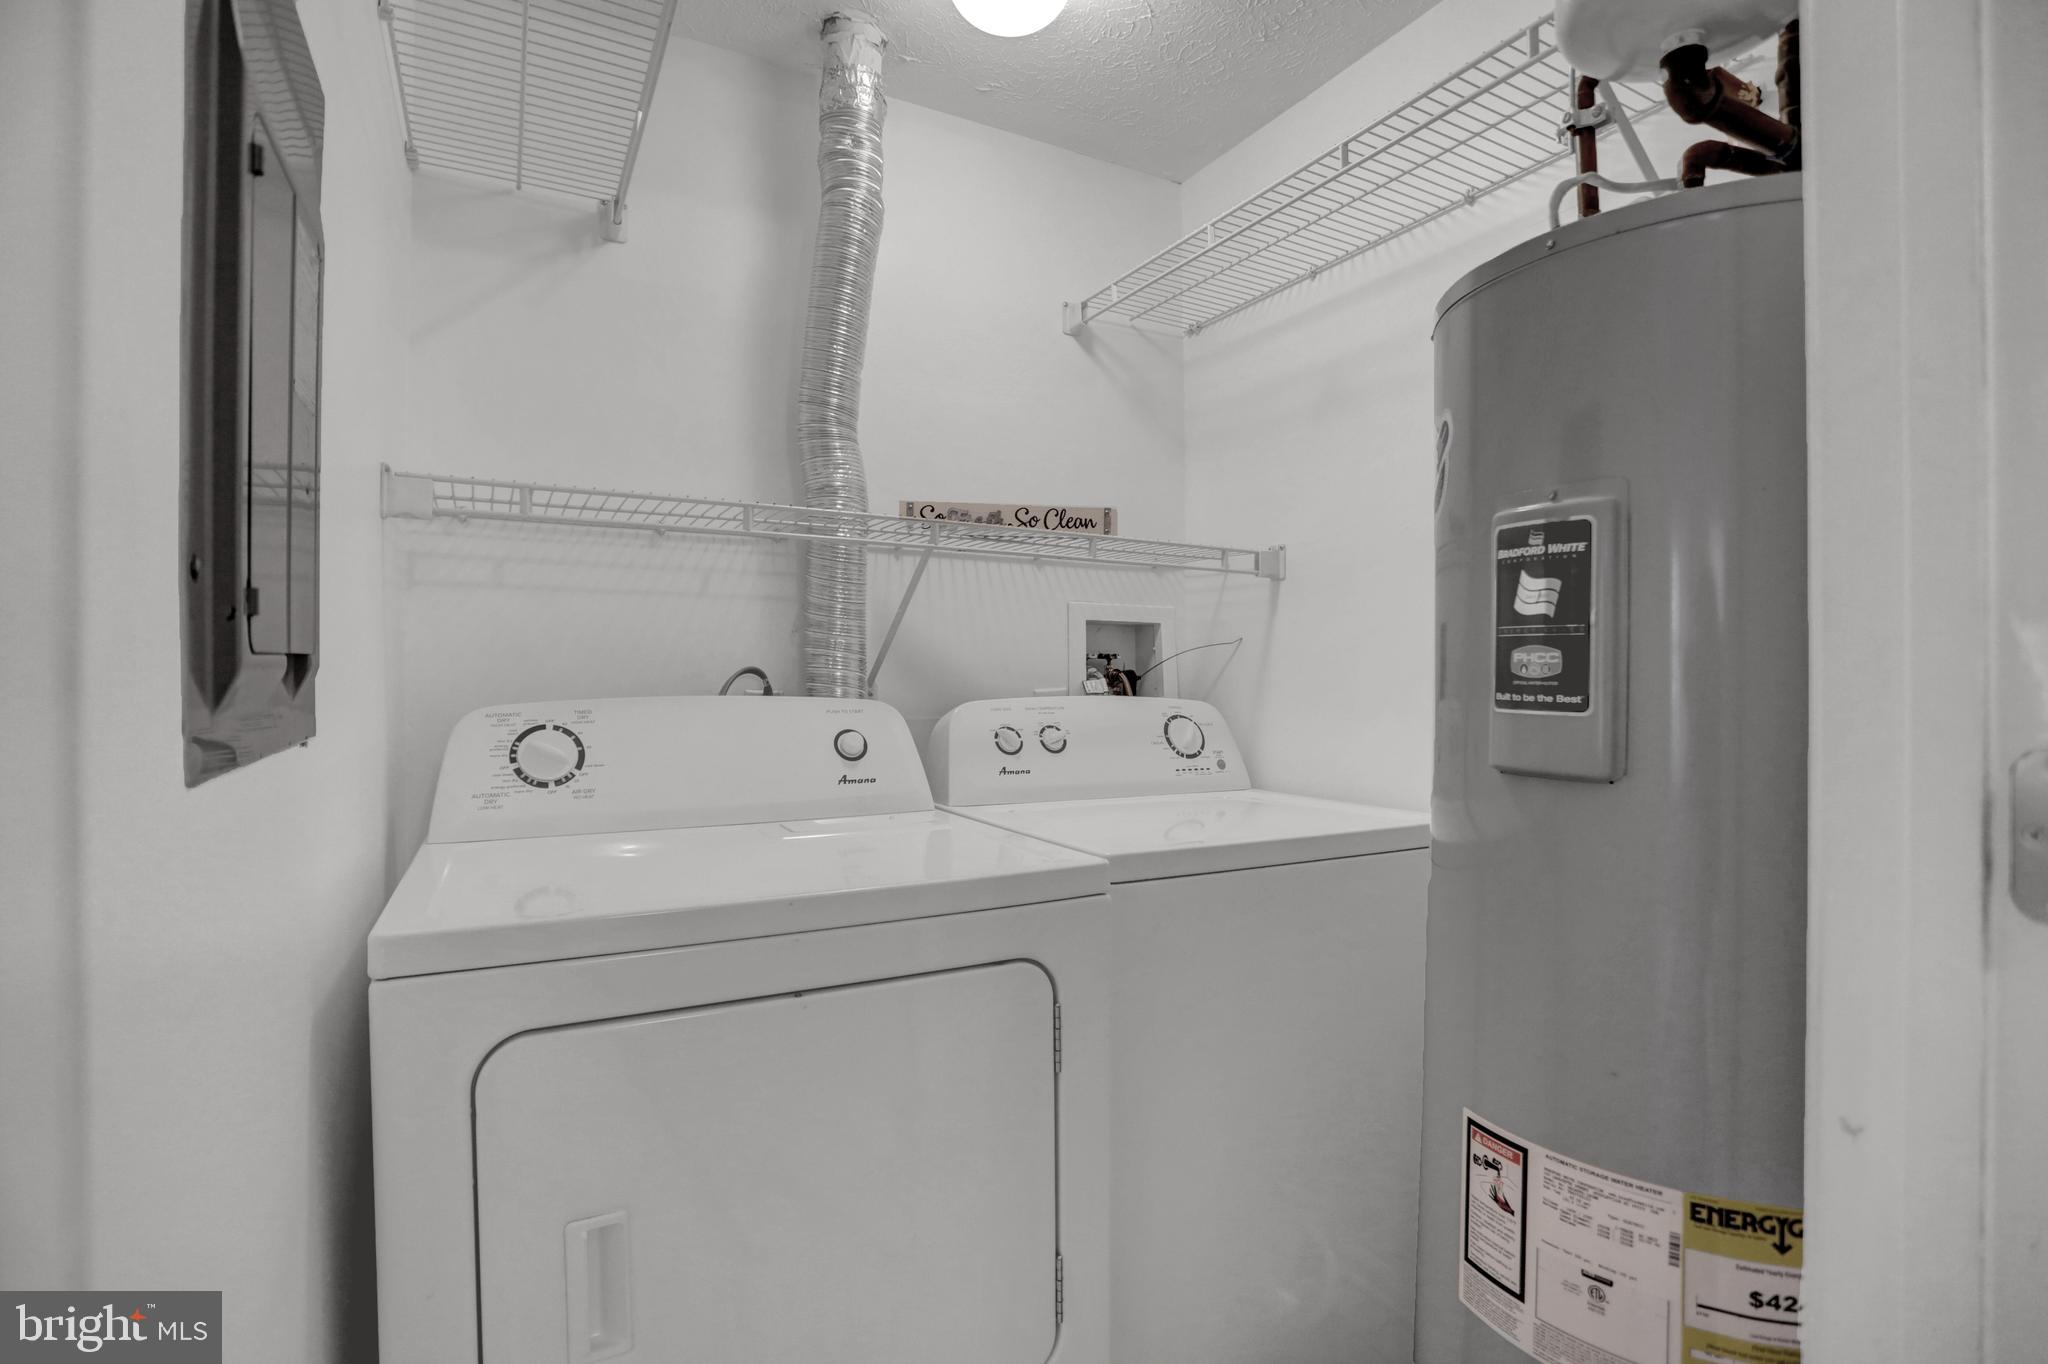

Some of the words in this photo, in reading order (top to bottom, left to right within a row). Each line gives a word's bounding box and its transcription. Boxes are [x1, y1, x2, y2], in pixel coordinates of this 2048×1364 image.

[1014, 507, 1041, 528] So
[1043, 508, 1097, 530] Clean
[1497, 545, 1545, 559] BRADFORD
[1547, 542, 1588, 553] WHITE
[1513, 652, 1560, 663] PHCC
[1523, 694, 1535, 702] be
[1537, 694, 1553, 702] the
[1556, 695, 1582, 704] Best
[999, 766, 1031, 776] Amana
[838, 775, 876, 785] Amana
[1482, 1136, 1514, 1161] DANGER
[1579, 1165, 1609, 1181] STORAGE
[1610, 1177, 1634, 1188] WATER
[1635, 1183, 1663, 1196] HEATER
[1749, 1290, 1803, 1313] $42
